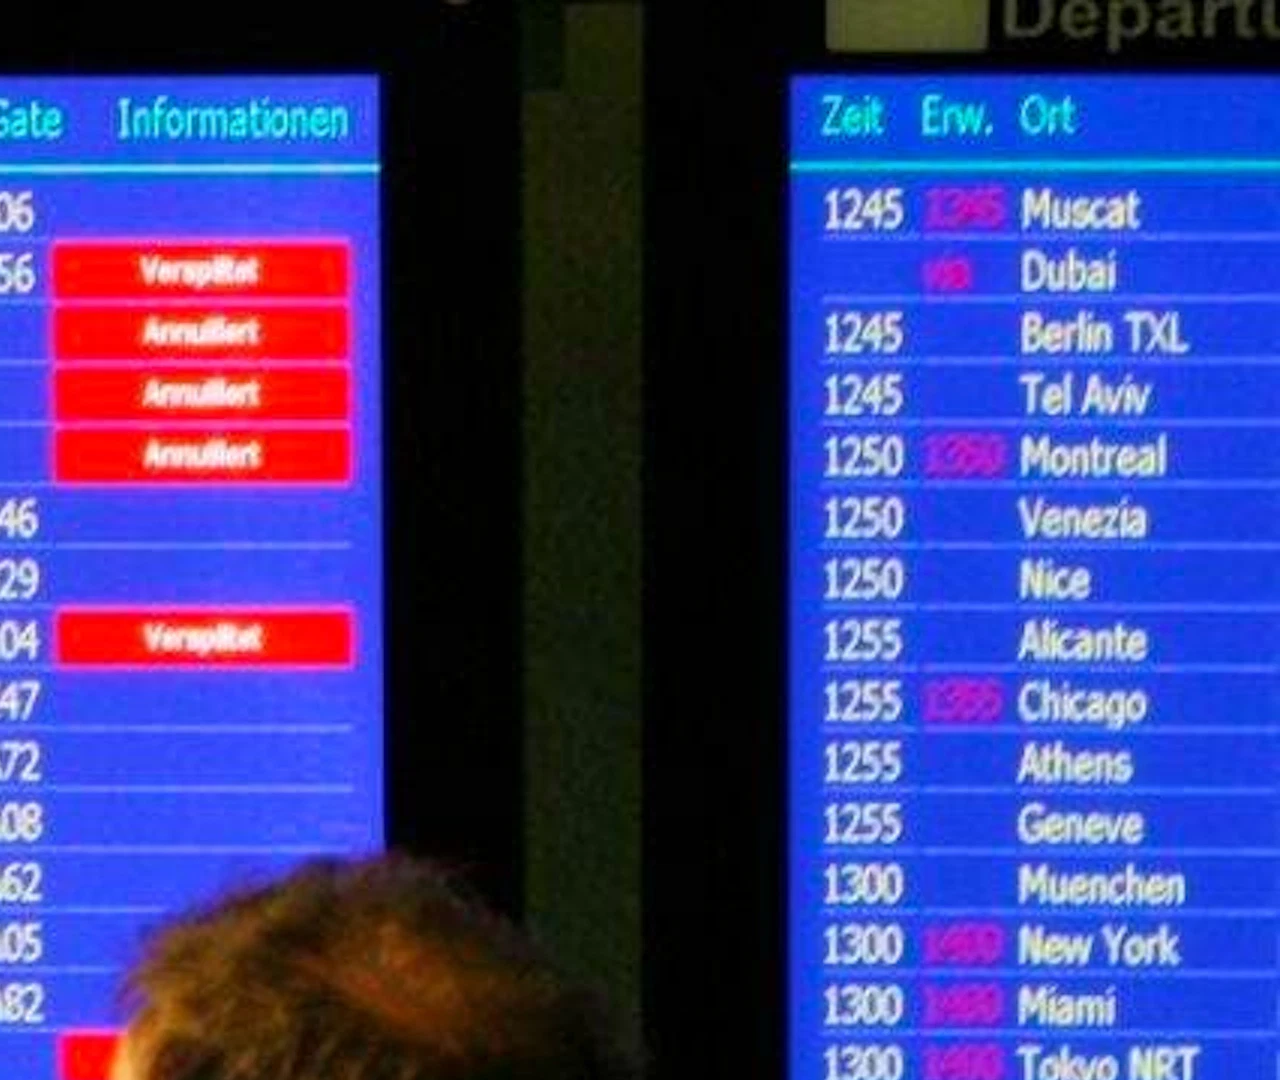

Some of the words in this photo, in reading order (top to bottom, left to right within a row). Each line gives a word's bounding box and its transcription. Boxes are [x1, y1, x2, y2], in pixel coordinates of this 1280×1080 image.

[119, 96, 348, 139] Informationen
[822, 95, 883, 135] Zeit
[922, 94, 993, 135] Erw.
[1020, 95, 1075, 135] Ort
[826, 188, 903, 229] 1245
[1022, 189, 1140, 229] Muscat
[1022, 249, 1116, 291] Dubai
[826, 312, 902, 353] 1245
[1022, 312, 1112, 353] Berlin
[1124, 311, 1188, 352] TXL
[826, 435, 903, 476] 1250
[1021, 435, 1166, 477] Montreal
[826, 498, 903, 538] 1250
[1019, 498, 1146, 538] Venezia
[826, 620, 902, 660] 1255
[1018, 619, 1146, 661] Alicante
[826, 681, 902, 721] 1255
[1019, 680, 1146, 730] Chicago
[825, 925, 903, 964] 1300
[1019, 925, 1093, 964] New
[1102, 926, 1180, 965] York
